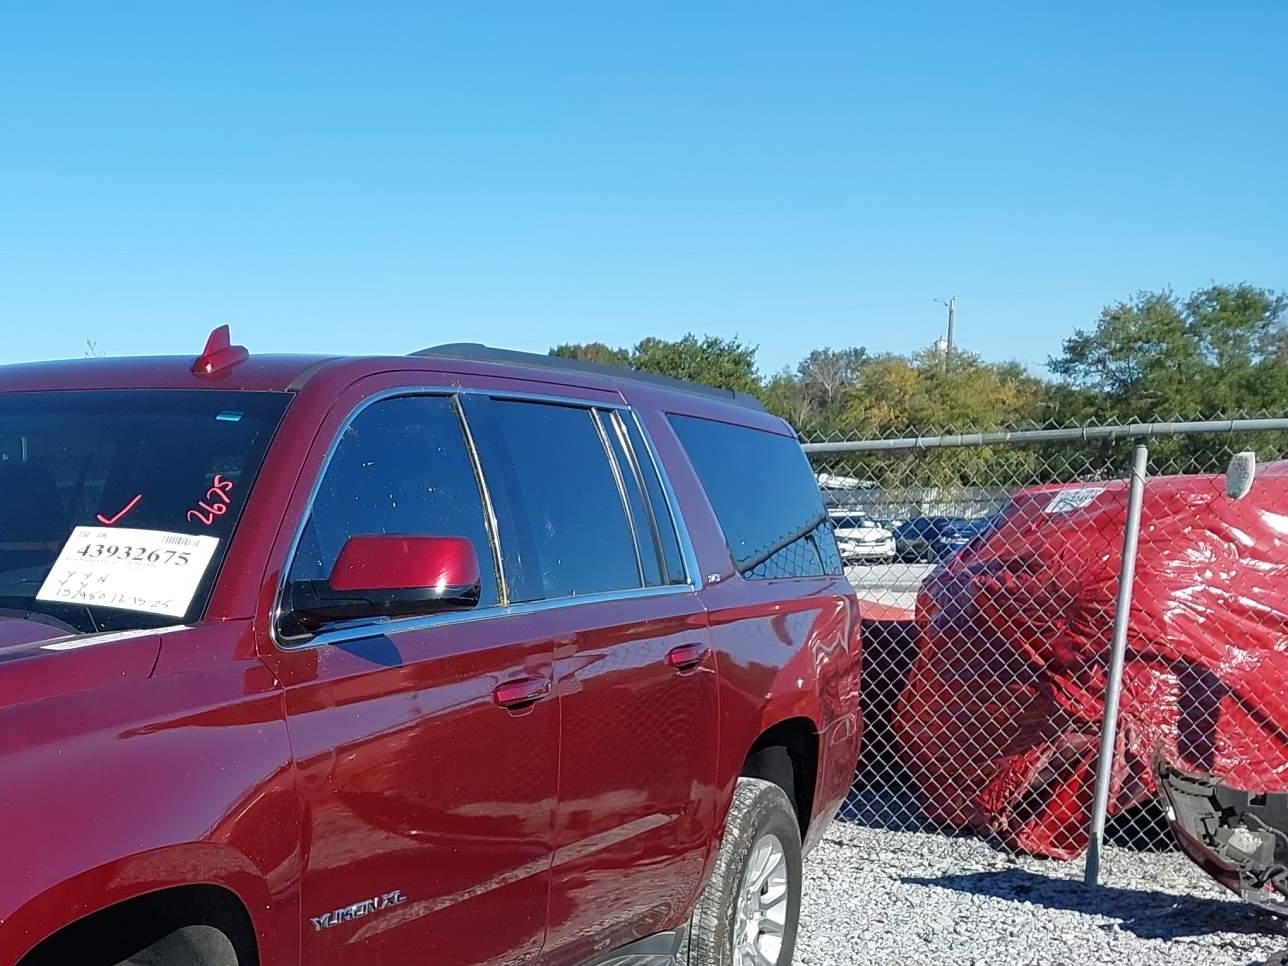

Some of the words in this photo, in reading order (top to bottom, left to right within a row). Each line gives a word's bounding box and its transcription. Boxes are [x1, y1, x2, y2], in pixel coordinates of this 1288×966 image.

[187, 474, 233, 526] 2675
[77, 543, 192, 566] 43932675
[379, 889, 409, 910] XL
